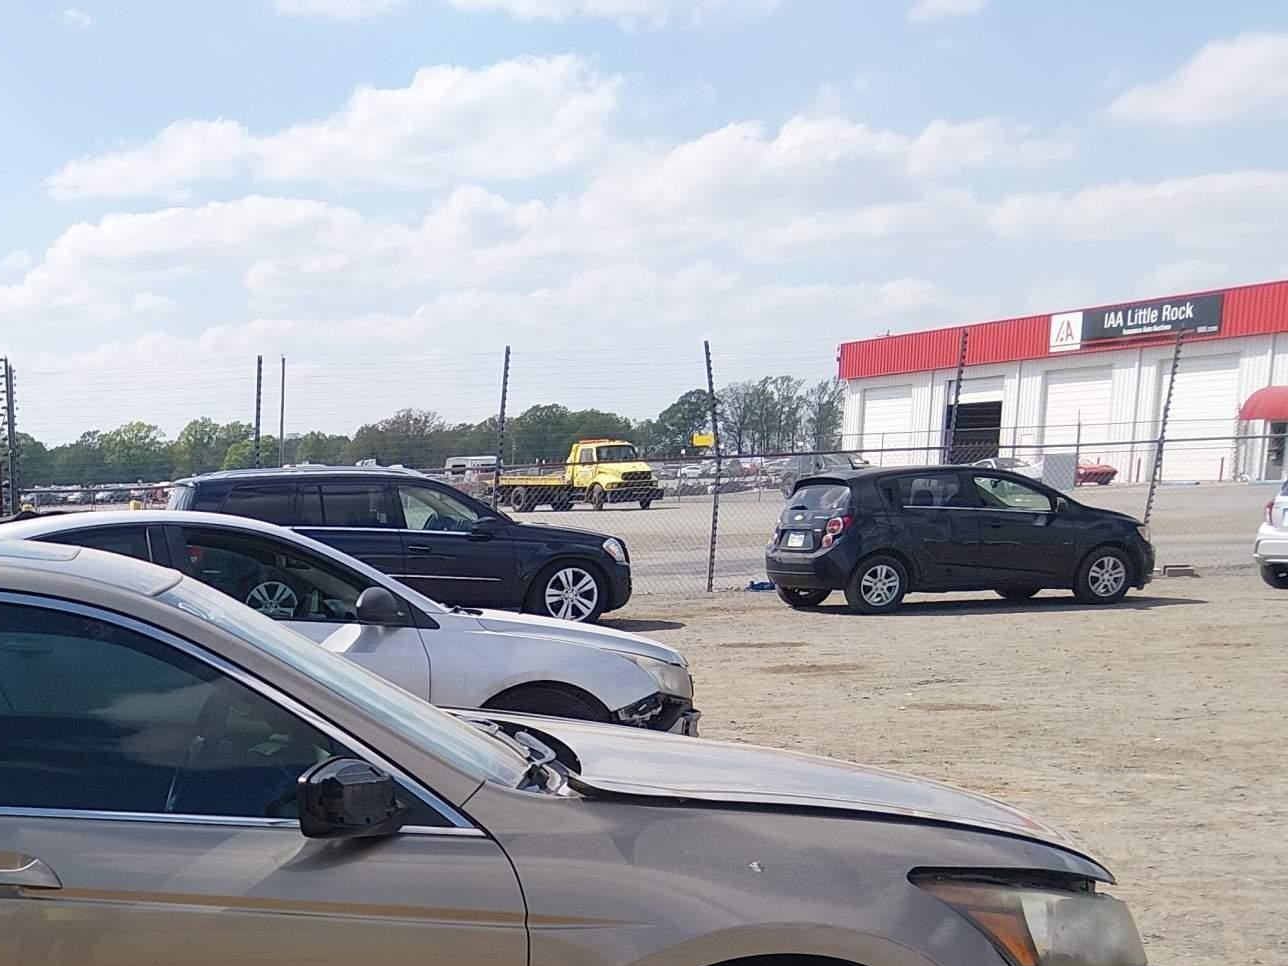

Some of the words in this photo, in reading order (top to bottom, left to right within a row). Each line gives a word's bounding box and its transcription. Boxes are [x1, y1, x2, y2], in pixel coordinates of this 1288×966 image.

[1104, 311, 1124, 329] IAA
[1127, 307, 1158, 327] Little
[1161, 302, 1195, 323] Rock
